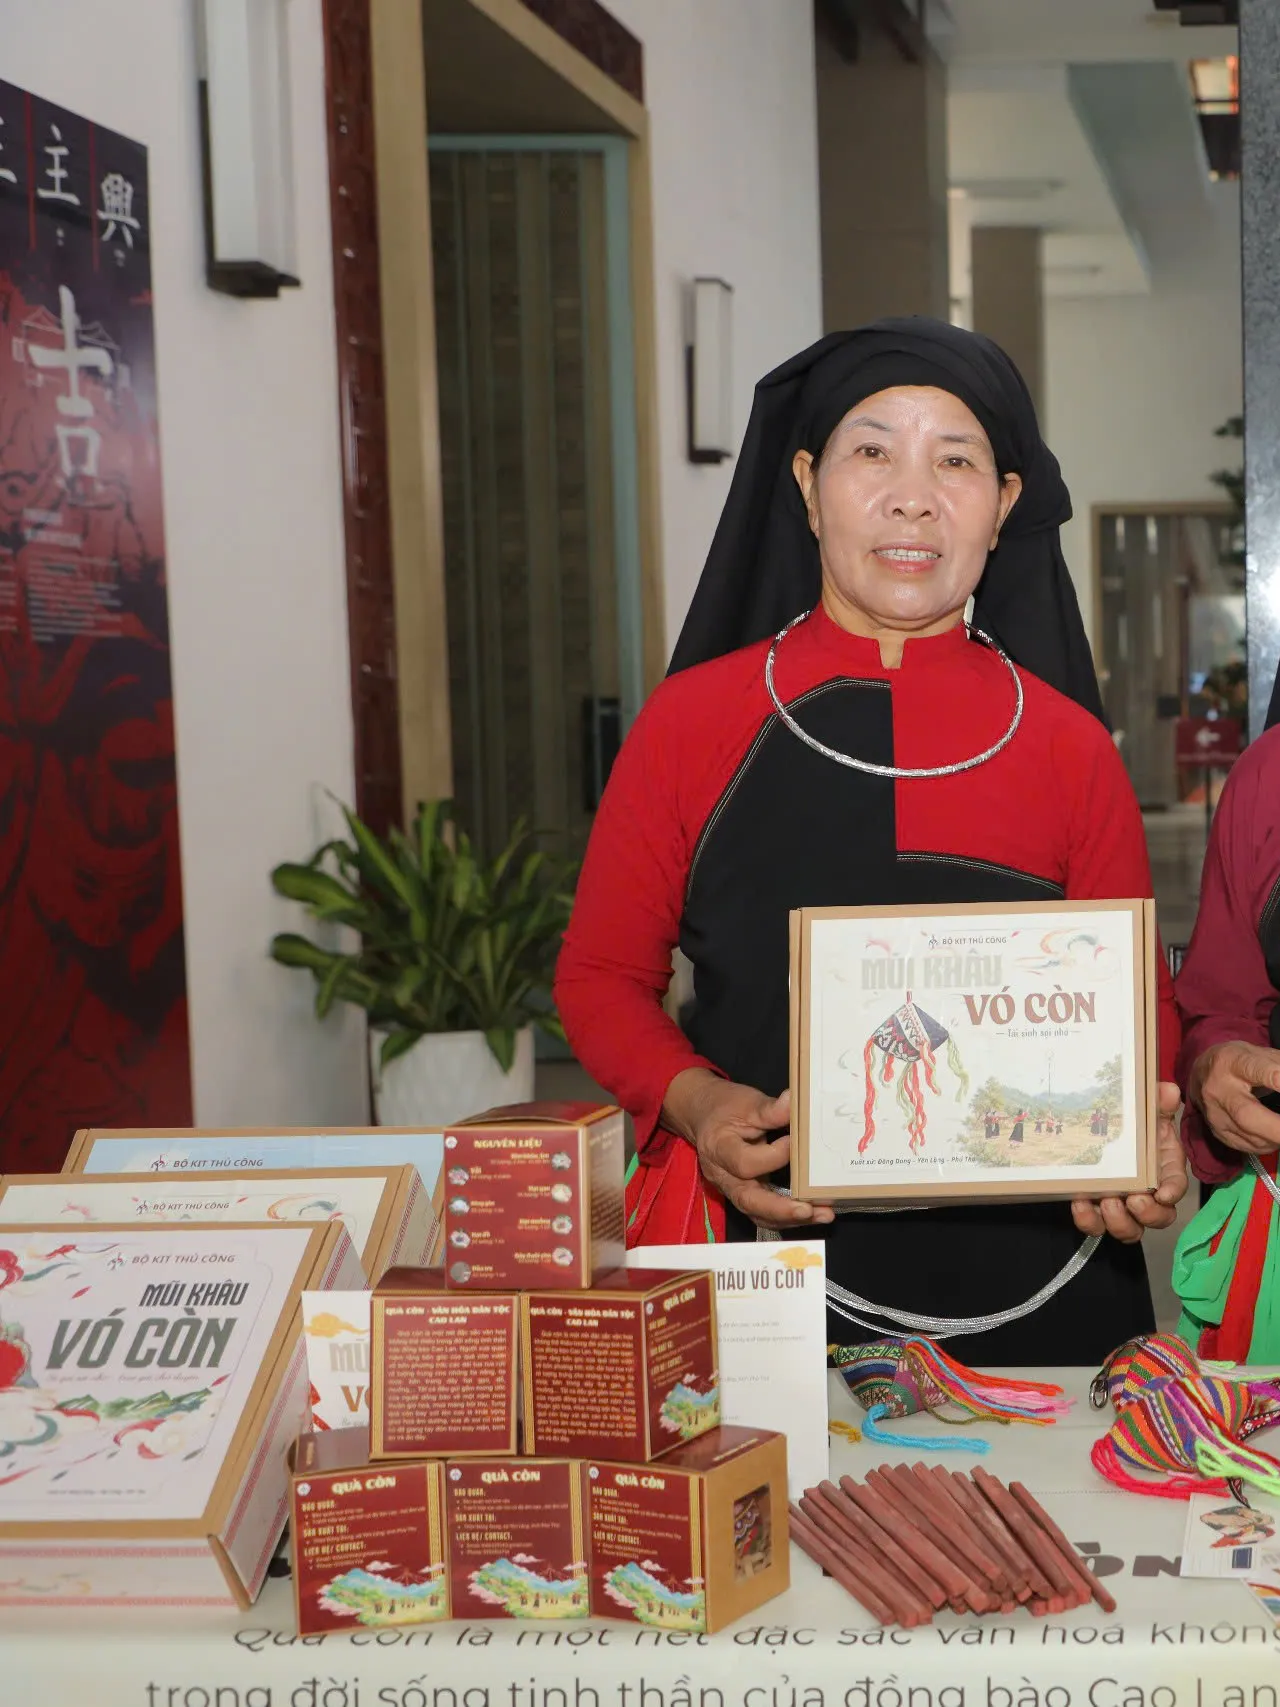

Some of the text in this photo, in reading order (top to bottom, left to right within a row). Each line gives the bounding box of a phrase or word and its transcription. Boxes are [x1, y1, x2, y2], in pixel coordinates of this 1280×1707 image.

[955, 937, 966, 945] KIT
[924, 948, 1003, 989] KHÂU
[963, 984, 1097, 1026] VÓ CÒN
[173, 1157, 263, 1169] BỘ KIT THỦ CÔNG
[152, 1202, 165, 1211] BỘ
[184, 1202, 203, 1210] THỦ
[204, 1202, 230, 1210] CÔNG
[131, 1252, 236, 1265] BỘ KIT THỦ CÔNG
[717, 1266, 805, 1291] HÂU VÓ CÒN
[139, 1278, 250, 1307] MŨI KHÂU
[45, 1307, 237, 1369] VÓ CÒN
[365, 1475, 397, 1490] CÒN
[512, 1468, 541, 1483] CÒN
[640, 1476, 666, 1490] CÒN
[1073, 1541, 1182, 1578] ÒN
[455, 1626, 494, 1647] là
[733, 1624, 818, 1655] đặc
[290, 1676, 360, 1707] đời
[377, 1675, 490, 1707] sống
[507, 1677, 600, 1707] tinh
[616, 1674, 725, 1707] thần
[743, 1674, 825, 1707] của
[844, 1673, 965, 1707] đồng
[986, 1675, 1072, 1707] bào
[1088, 1677, 1177, 1707] Cao
